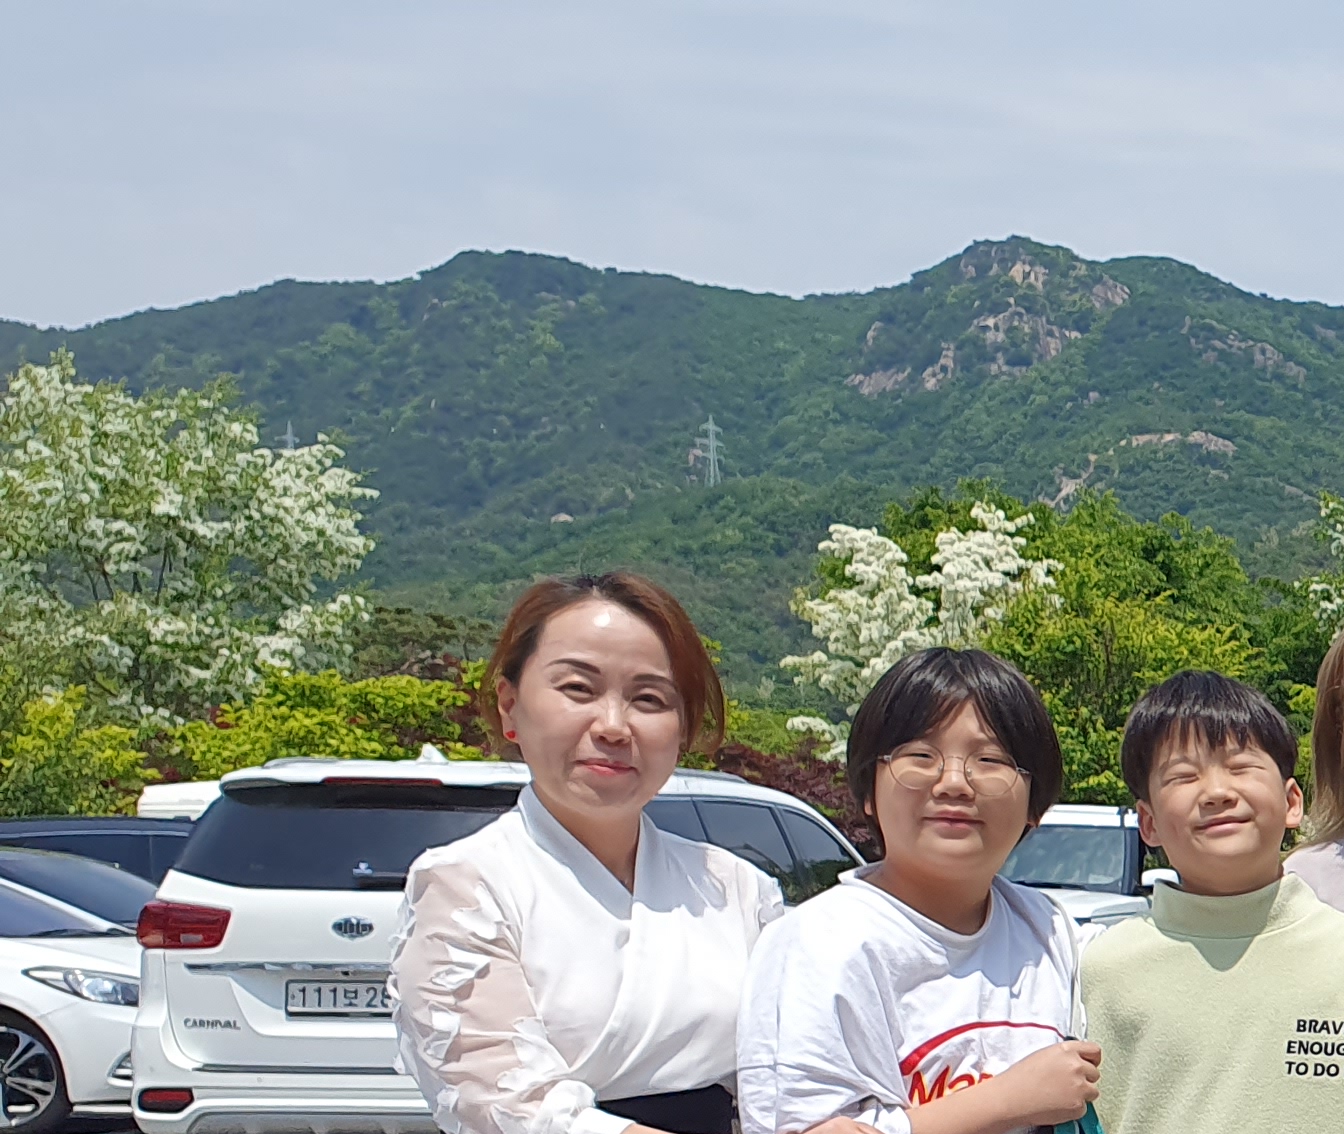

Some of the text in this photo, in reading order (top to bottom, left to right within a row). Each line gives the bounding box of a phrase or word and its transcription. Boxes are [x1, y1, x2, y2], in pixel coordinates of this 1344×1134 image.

[184, 1017, 241, 1031] CARNIVAL
[1284, 1060, 1309, 1076] TO
[1312, 1062, 1340, 1078] DO
